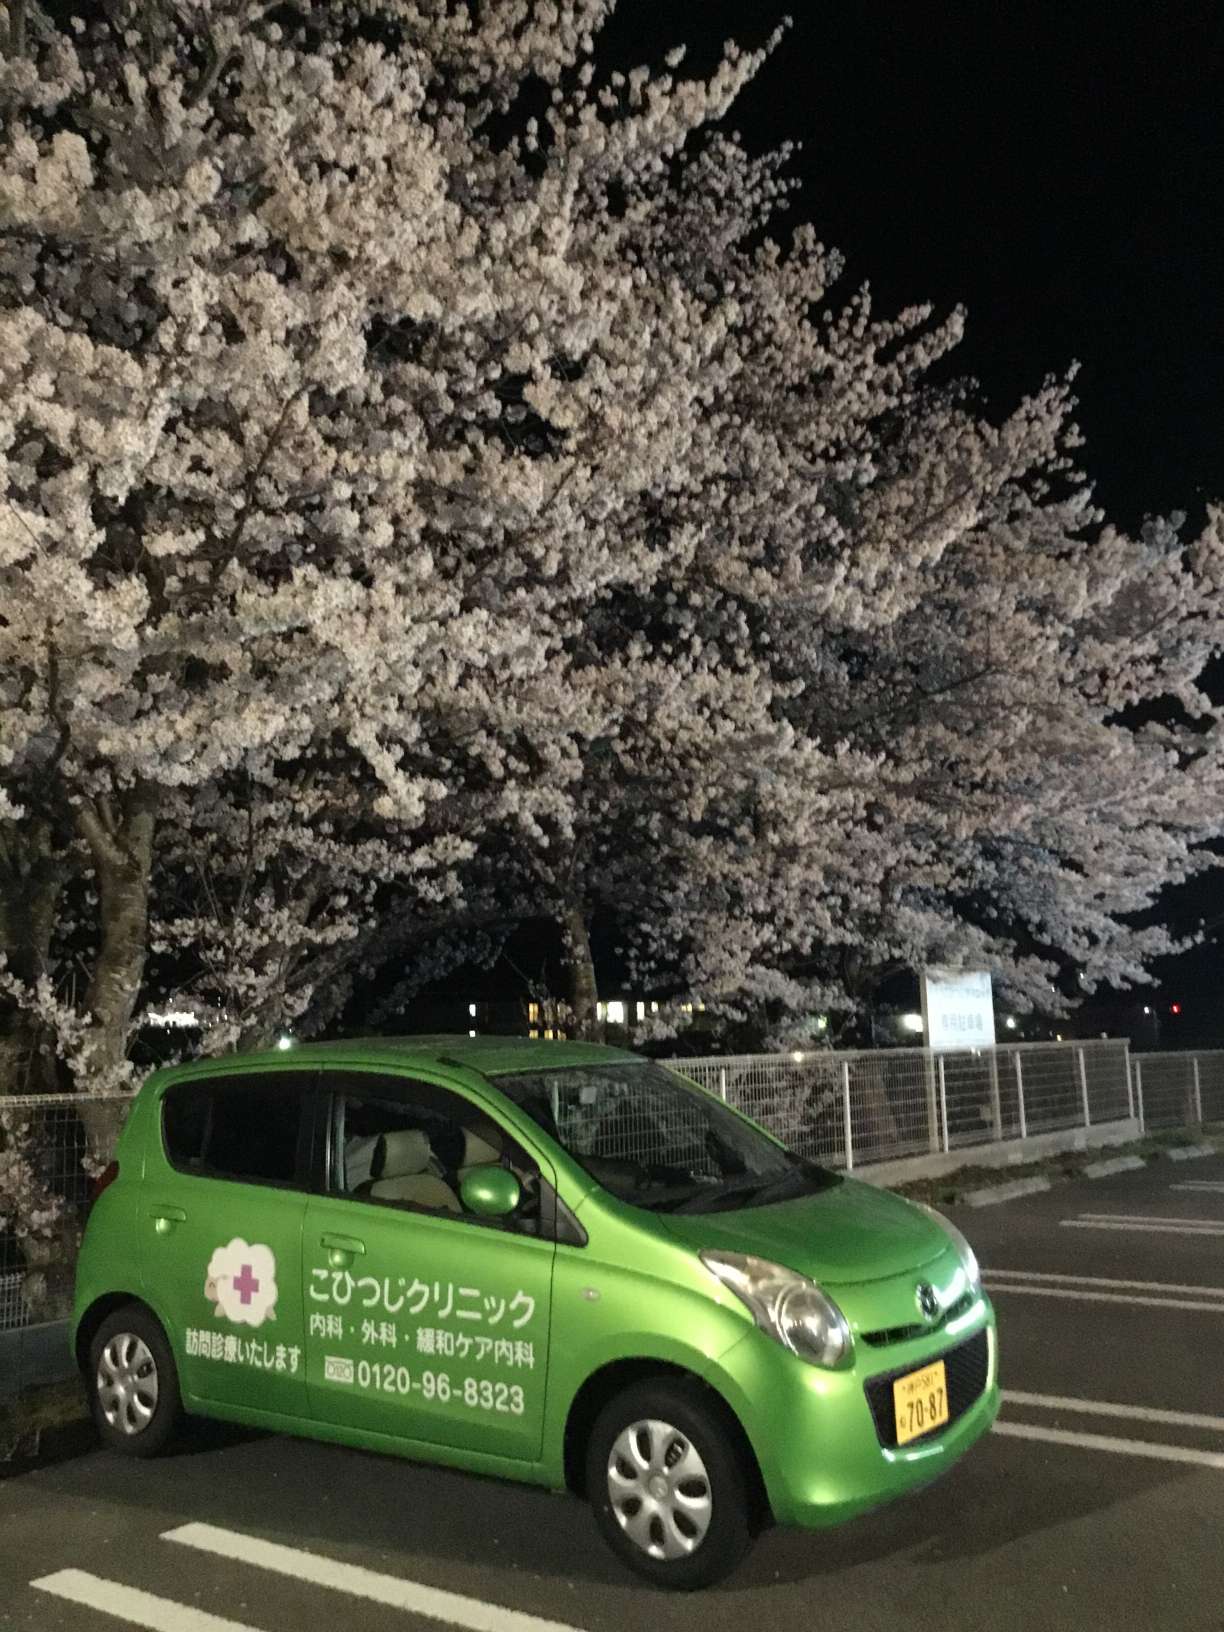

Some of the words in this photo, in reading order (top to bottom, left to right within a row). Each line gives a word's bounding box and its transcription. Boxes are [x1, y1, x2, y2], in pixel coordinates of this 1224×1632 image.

[310, 1268, 535, 1328] こひつじクリニック
[186, 1328, 301, 1373] 訪問診療いたします
[358, 1360, 525, 1415] 0120-96-8323
